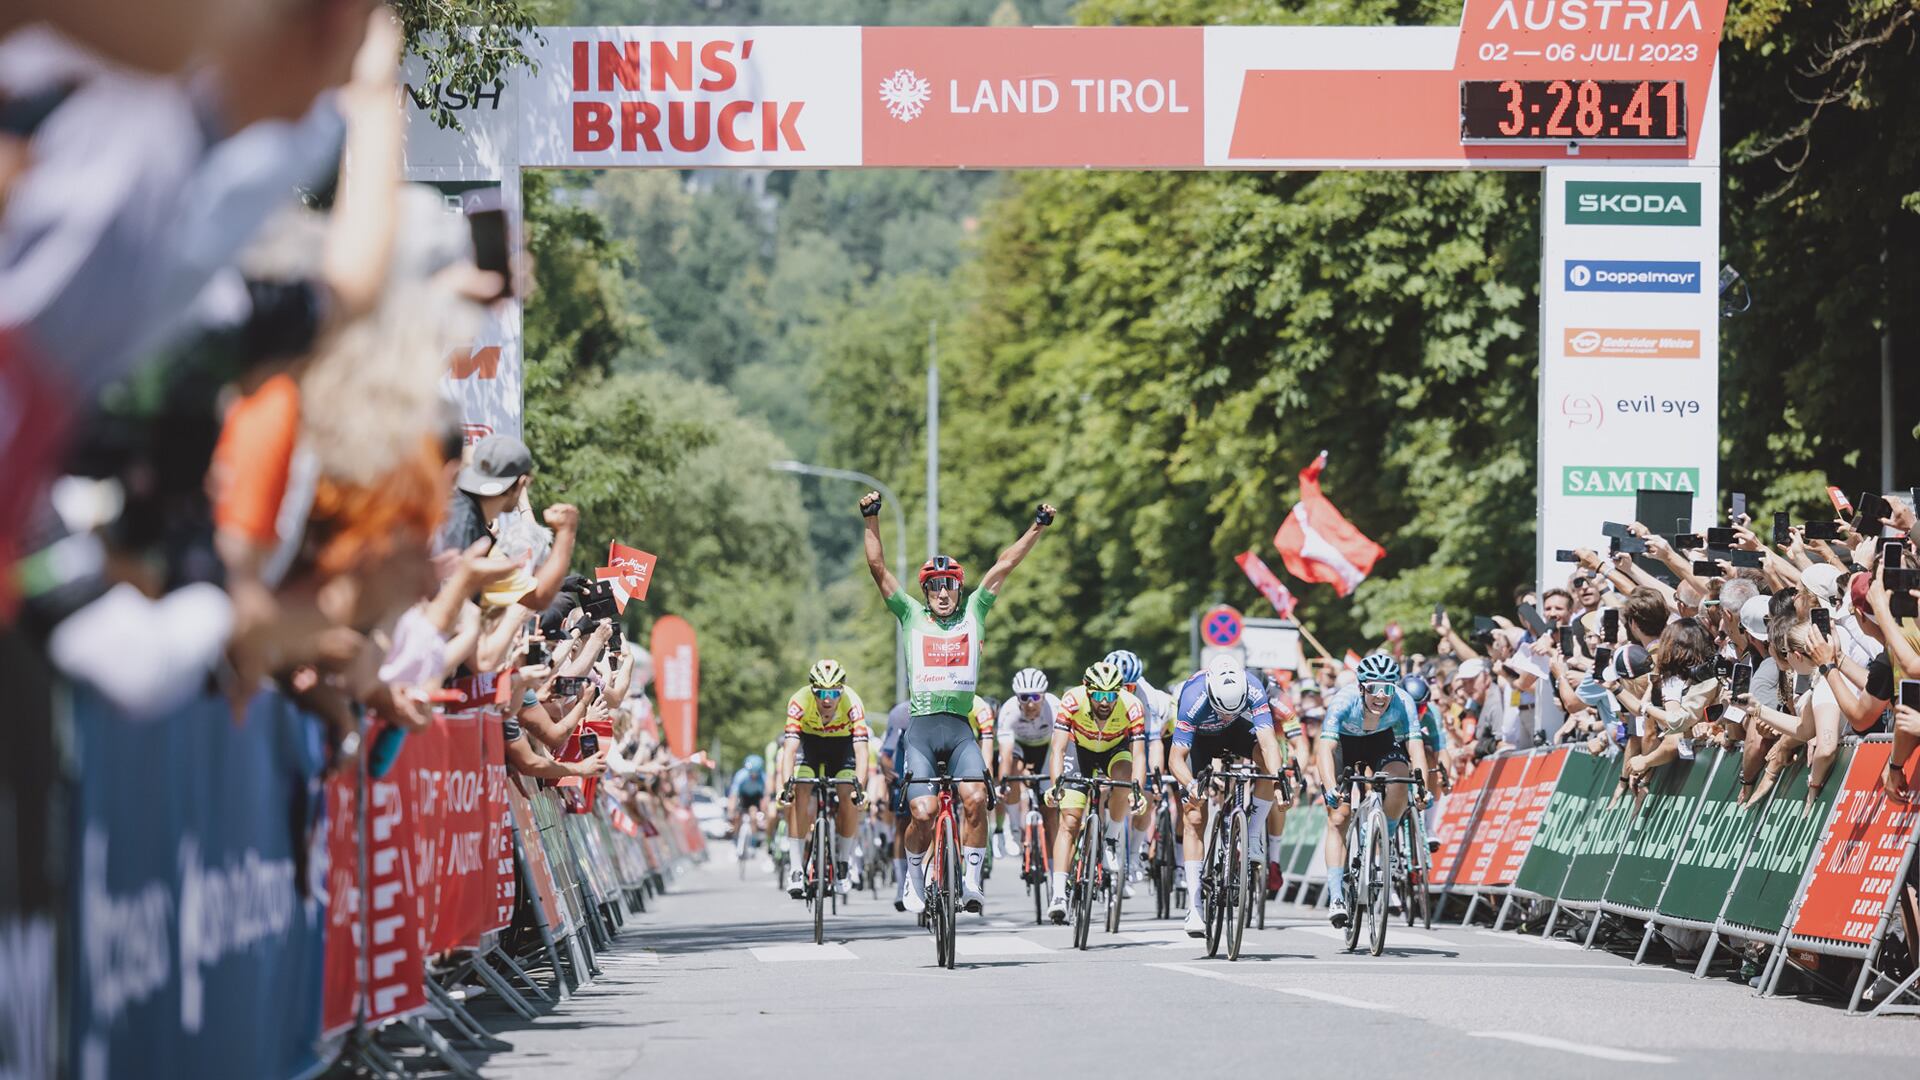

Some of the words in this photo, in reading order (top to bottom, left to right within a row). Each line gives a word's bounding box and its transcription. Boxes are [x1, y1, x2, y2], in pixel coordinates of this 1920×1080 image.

[1486, 0, 1702, 30] AUSTRIA
[1478, 43, 1509, 61] 02
[1545, 43, 1576, 61] 06
[1580, 44, 1634, 62] JULI
[1639, 44, 1698, 62] 2023
[949, 79, 1060, 113] LAND
[1071, 79, 1190, 113] TIROL
[1498, 80, 1678, 136] 3:28:41
[572, 101, 806, 152] BRUCK
[1595, 270, 1696, 285] Doppelmayr
[1617, 395, 1655, 413] evil
[1661, 400, 1700, 417] eye
[1568, 471, 1696, 492] SAMINA
